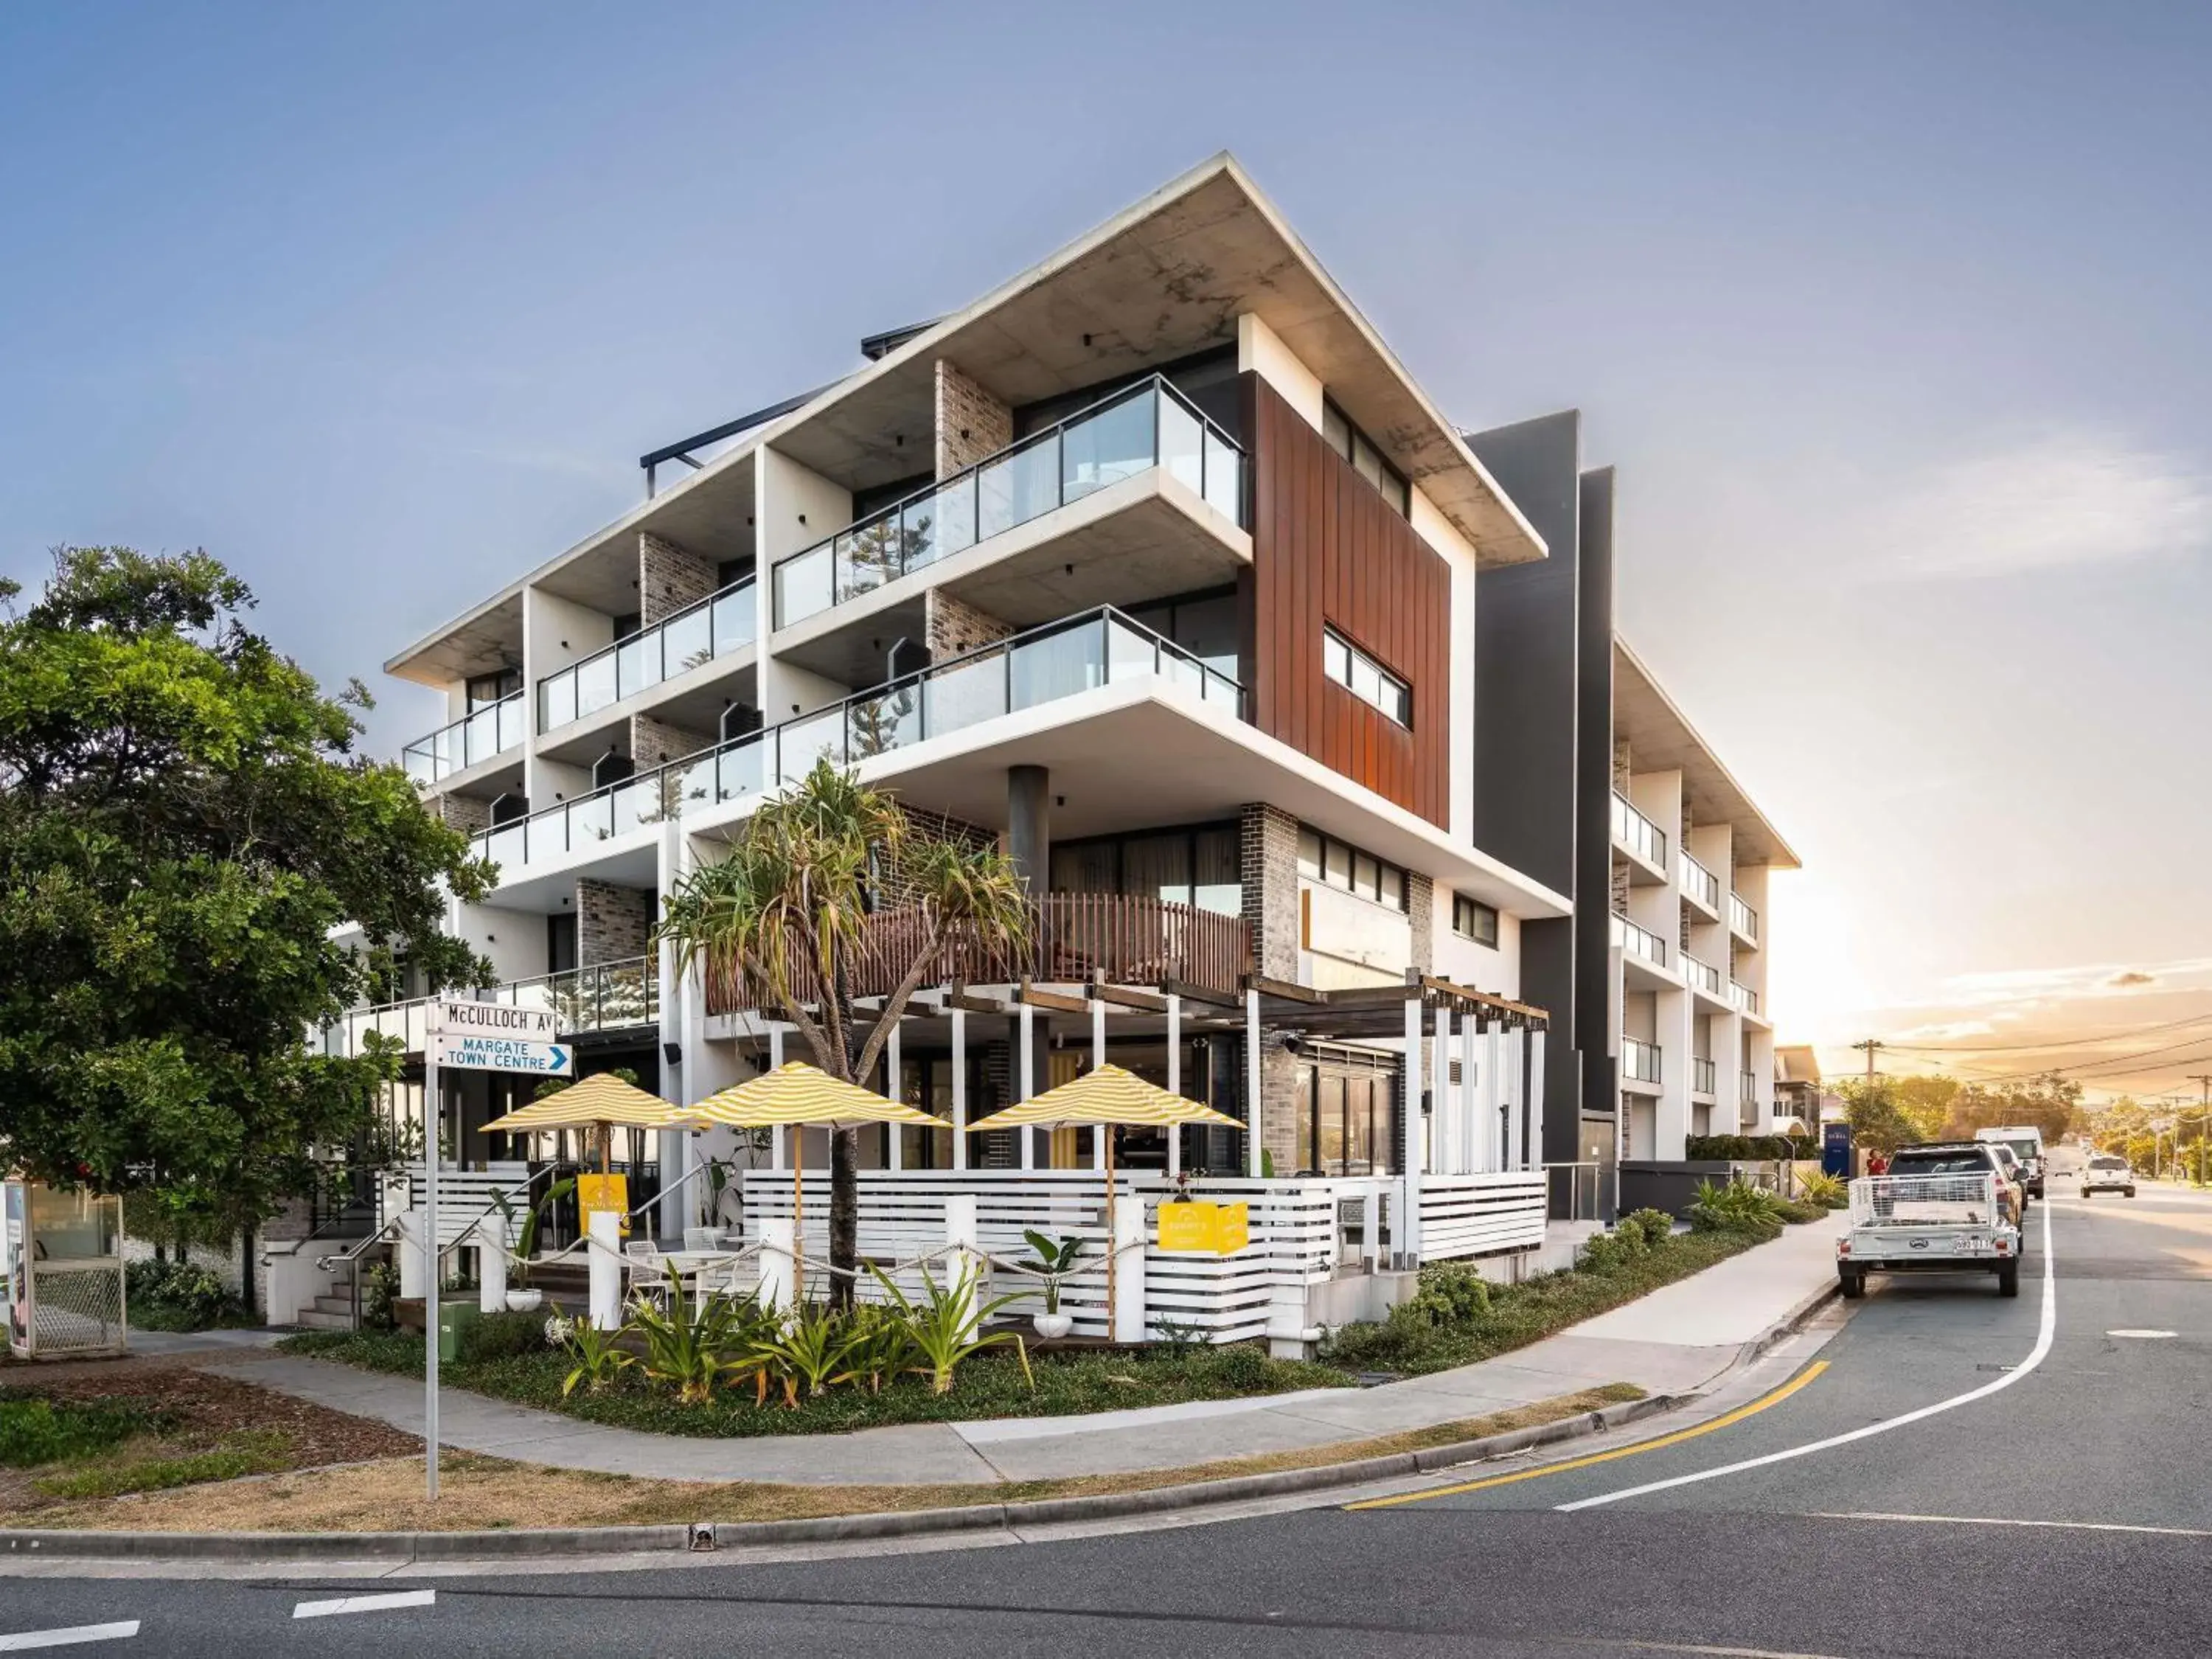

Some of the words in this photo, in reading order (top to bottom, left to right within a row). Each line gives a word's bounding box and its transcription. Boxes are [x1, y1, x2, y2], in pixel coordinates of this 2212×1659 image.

[448, 1005, 527, 1029] McCULLOCH
[463, 1038, 529, 1055] MARGATE
[448, 1051, 487, 1065] TOWN
[495, 1054, 546, 1070] CENTRE
